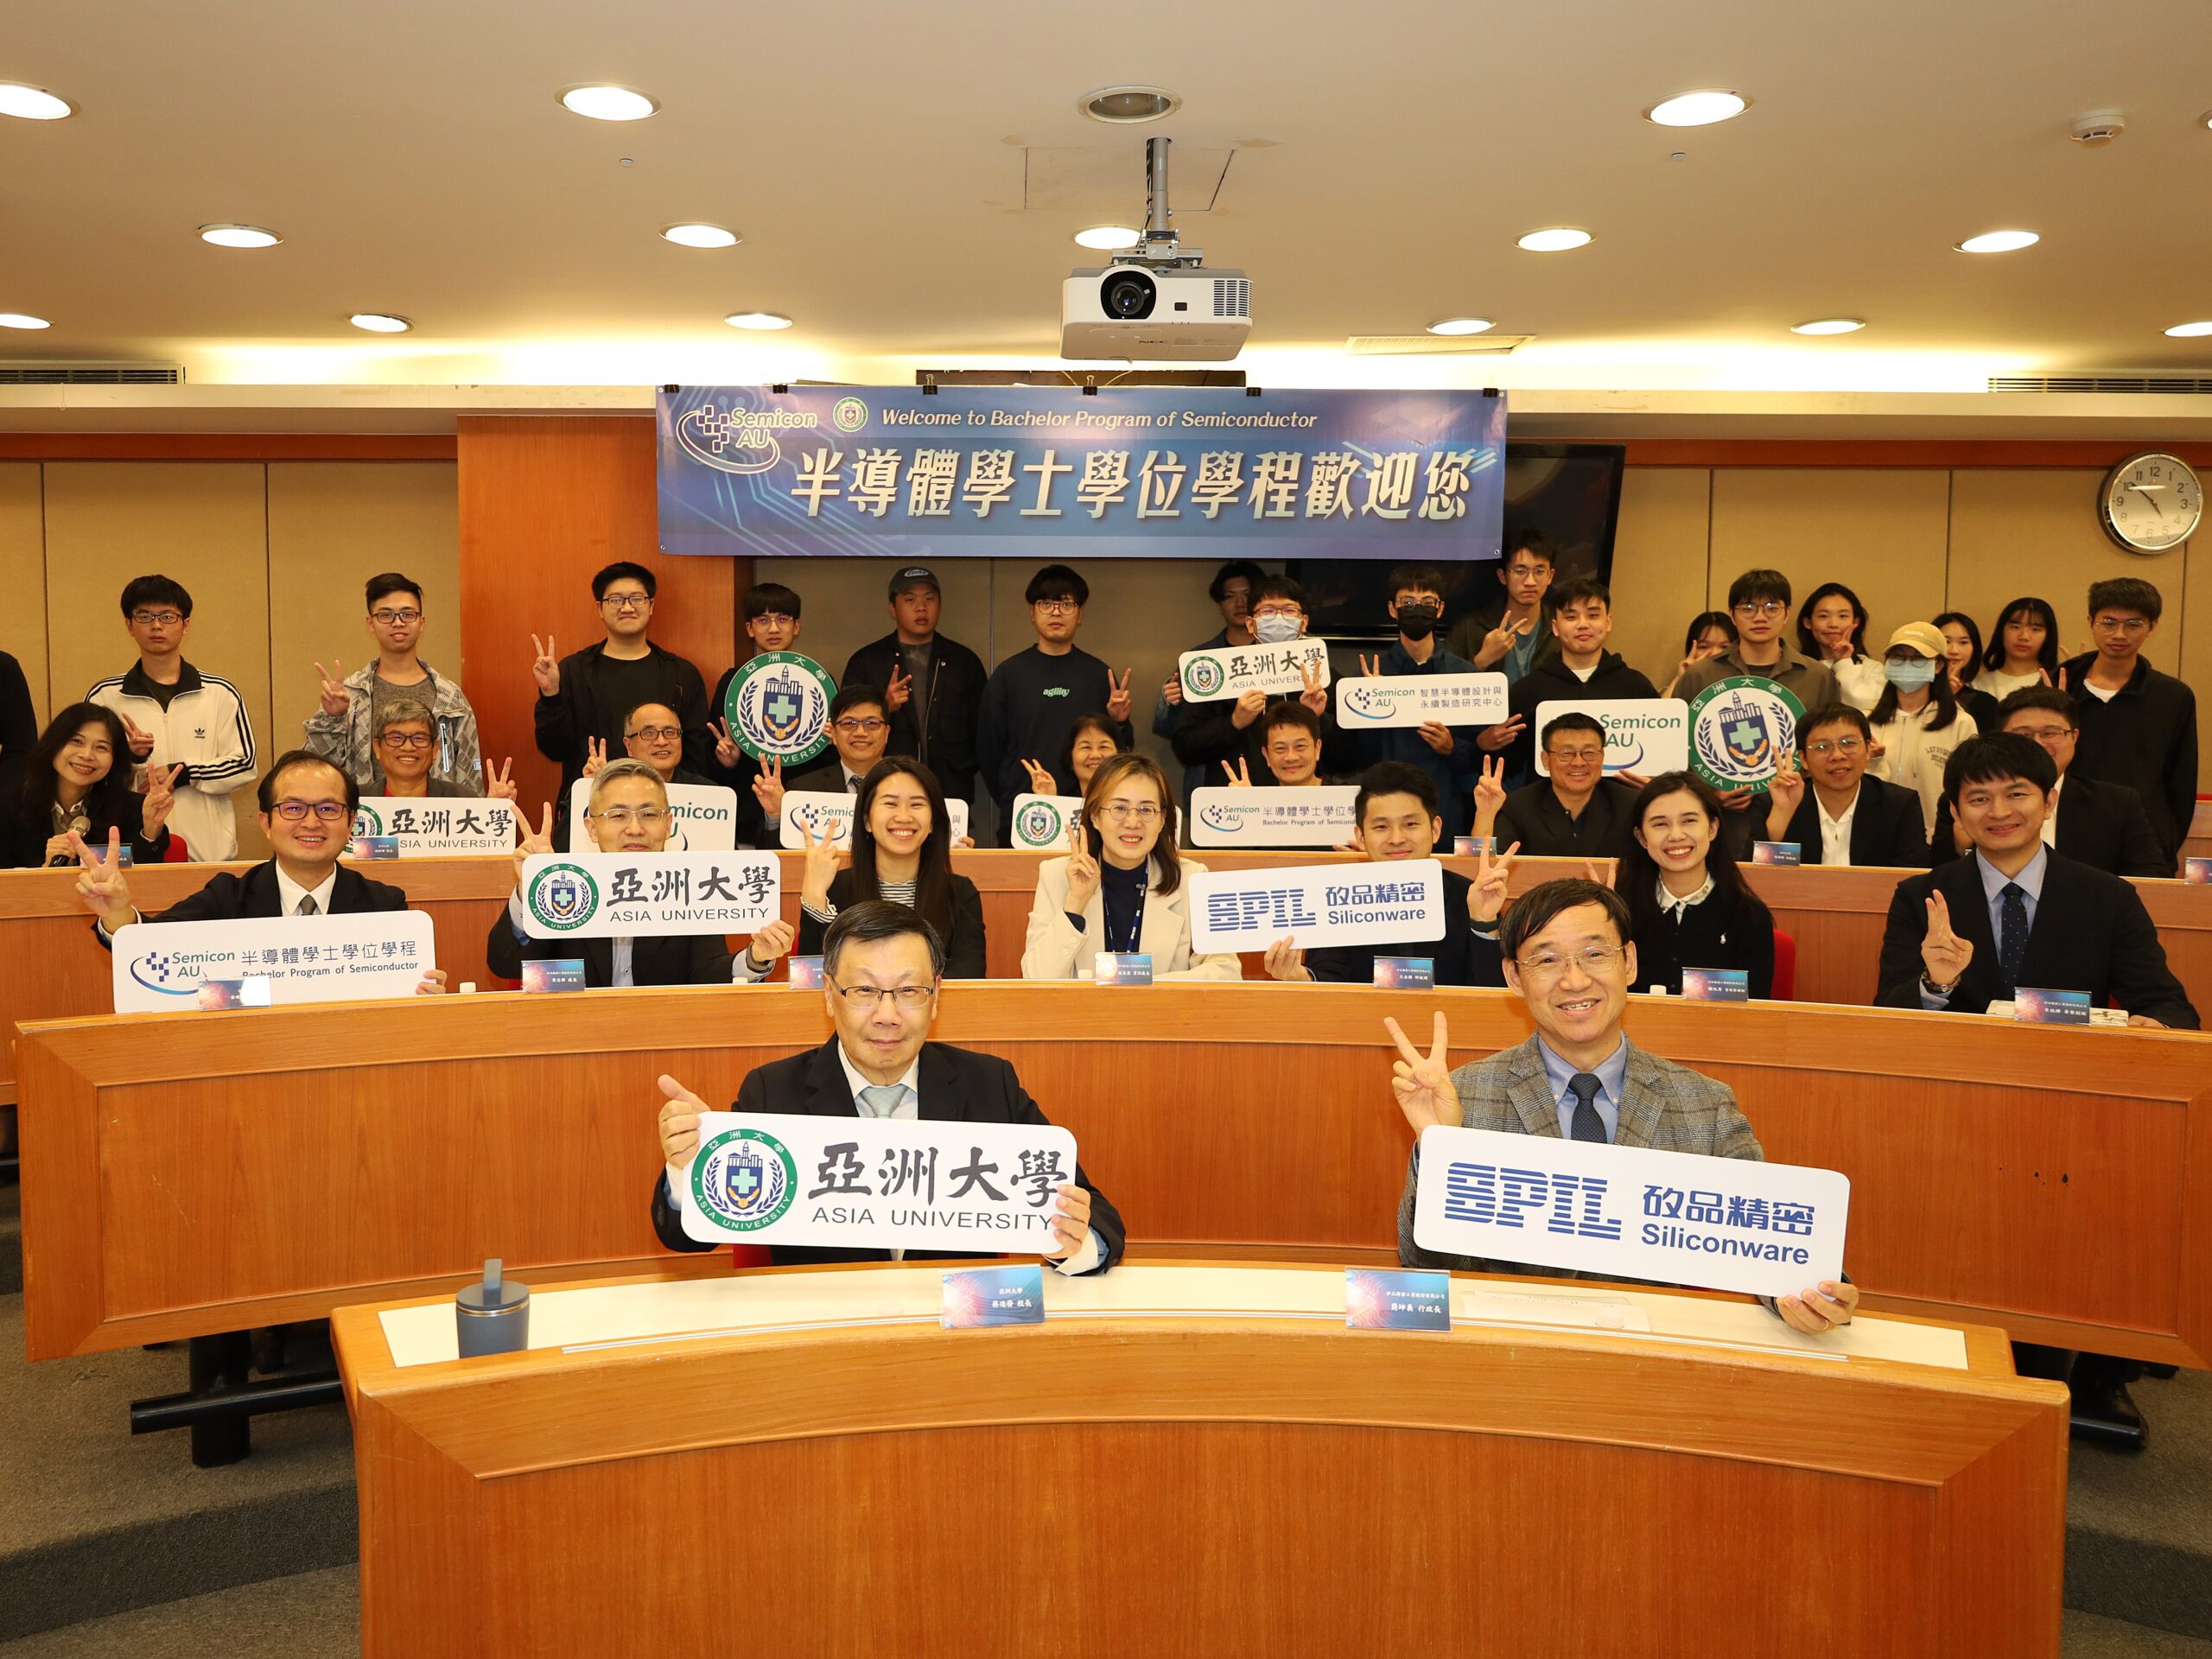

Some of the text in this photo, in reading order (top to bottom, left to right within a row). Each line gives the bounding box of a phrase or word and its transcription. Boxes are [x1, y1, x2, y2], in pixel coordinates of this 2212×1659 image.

[730, 407, 817, 429] Semicon
[881, 409, 1318, 431] Welcome to Bachelor Program of Semiconductor
[735, 429, 771, 448] AU
[2136, 471, 2143, 480] 11
[2150, 467, 2160, 477] 12
[791, 447, 1472, 520] 半導體學士學位學程歡迎您
[2177, 483, 2184, 493] 2
[2116, 497, 2124, 506] 9
[2180, 499, 2189, 509] 3
[2120, 512, 2128, 523] 8
[2173, 515, 2181, 524] 4
[2133, 524, 2139, 534] 7
[2145, 529, 2153, 538] 6
[2162, 525, 2170, 535] 5
[744, 652, 826, 681] 亞洲大學
[1229, 647, 1325, 680] 亞洲大學
[1231, 680, 1256, 689] ASIA
[1372, 687, 1415, 697] Semicon
[1420, 686, 1502, 697] 智慧半導體設計與
[1376, 698, 1391, 707] AU
[1420, 697, 1503, 709] 永續製造研究中心
[1691, 677, 1782, 712] 亞洲大學
[1599, 714, 1681, 729] Semicon
[730, 722, 826, 763] ASIA NVERSIT
[1605, 733, 1634, 747] AU
[1694, 763, 1724, 787] ASIA
[668, 802, 728, 821] micon
[821, 805, 855, 817] Semic
[1262, 806, 1356, 817] 半導體學士學位學
[388, 809, 512, 837] 亞洲大學
[429, 839, 507, 848] UNIVERSITY
[607, 866, 775, 906] 亞洲大學
[1325, 881, 1425, 906] 矽品精密
[532, 906, 594, 930] ASIA UNIVERSITY
[610, 907, 769, 922] ASIA UNIVERSITY
[1208, 888, 1317, 931] SPIL
[1328, 907, 1426, 925] Siliconware
[172, 950, 235, 964] Semicon
[241, 940, 416, 965] 半導體學士學位學程
[177, 966, 200, 978] AU
[290, 966, 329, 978] Program
[335, 964, 345, 974] of
[349, 961, 418, 972] Semiconductor
[708, 1130, 785, 1153] 亞洲大學
[808, 1142, 1068, 1207] 亞洲大學
[1445, 1162, 1622, 1240] SPIL
[696, 1194, 790, 1229] ASIA UNIVERSITY
[812, 1207, 1051, 1230] ASIA UNIVERSITY
[1643, 1185, 1814, 1236] 矽品精密
[1641, 1223, 1809, 1264] Siliconware
